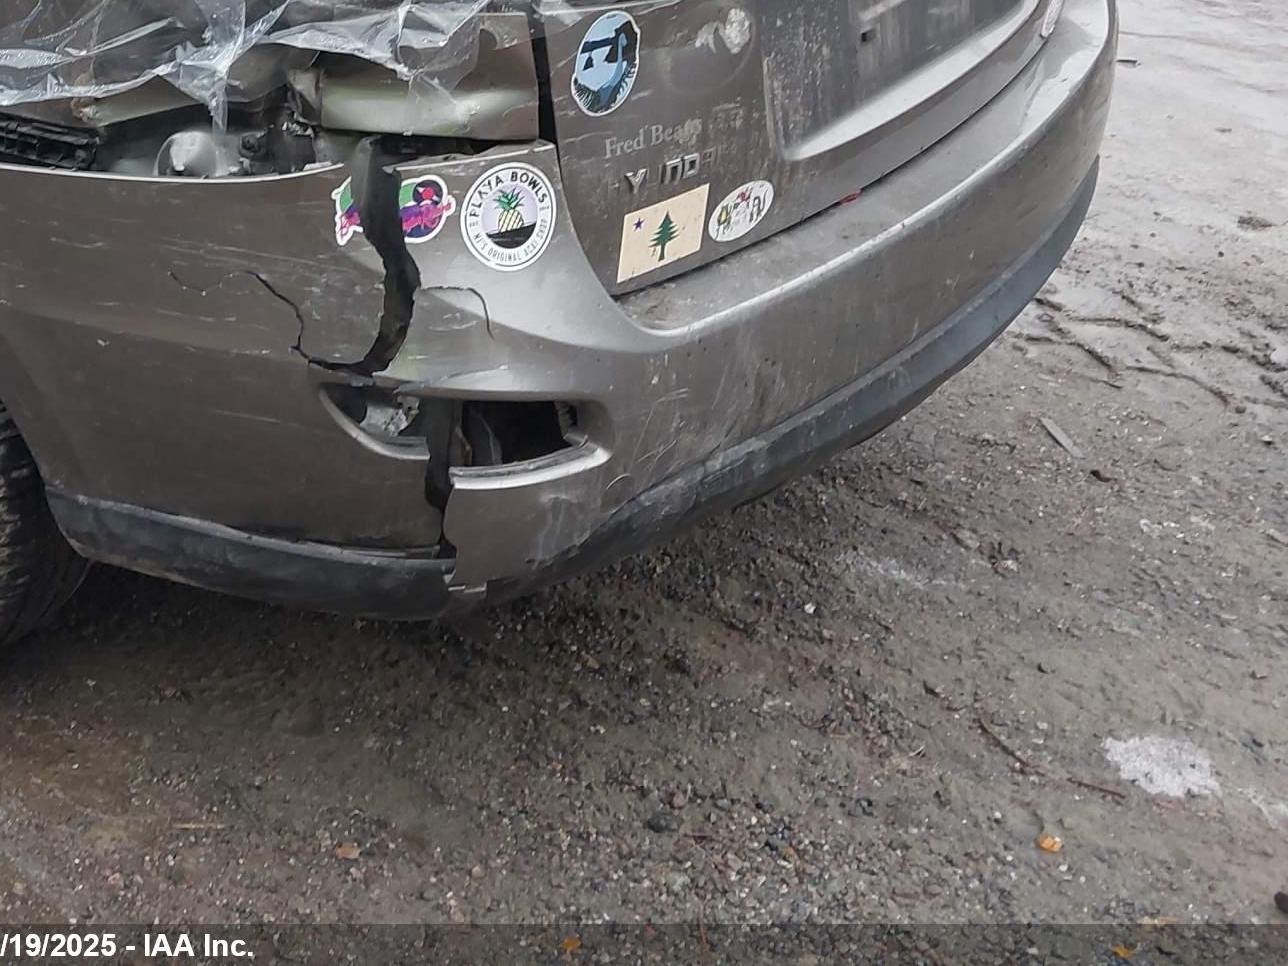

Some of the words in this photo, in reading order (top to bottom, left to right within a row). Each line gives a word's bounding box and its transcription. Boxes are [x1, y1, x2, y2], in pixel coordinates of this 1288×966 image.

[604, 127, 646, 159] Fred
[469, 175, 504, 218] PLAYA
[510, 171, 548, 203] BOWLS
